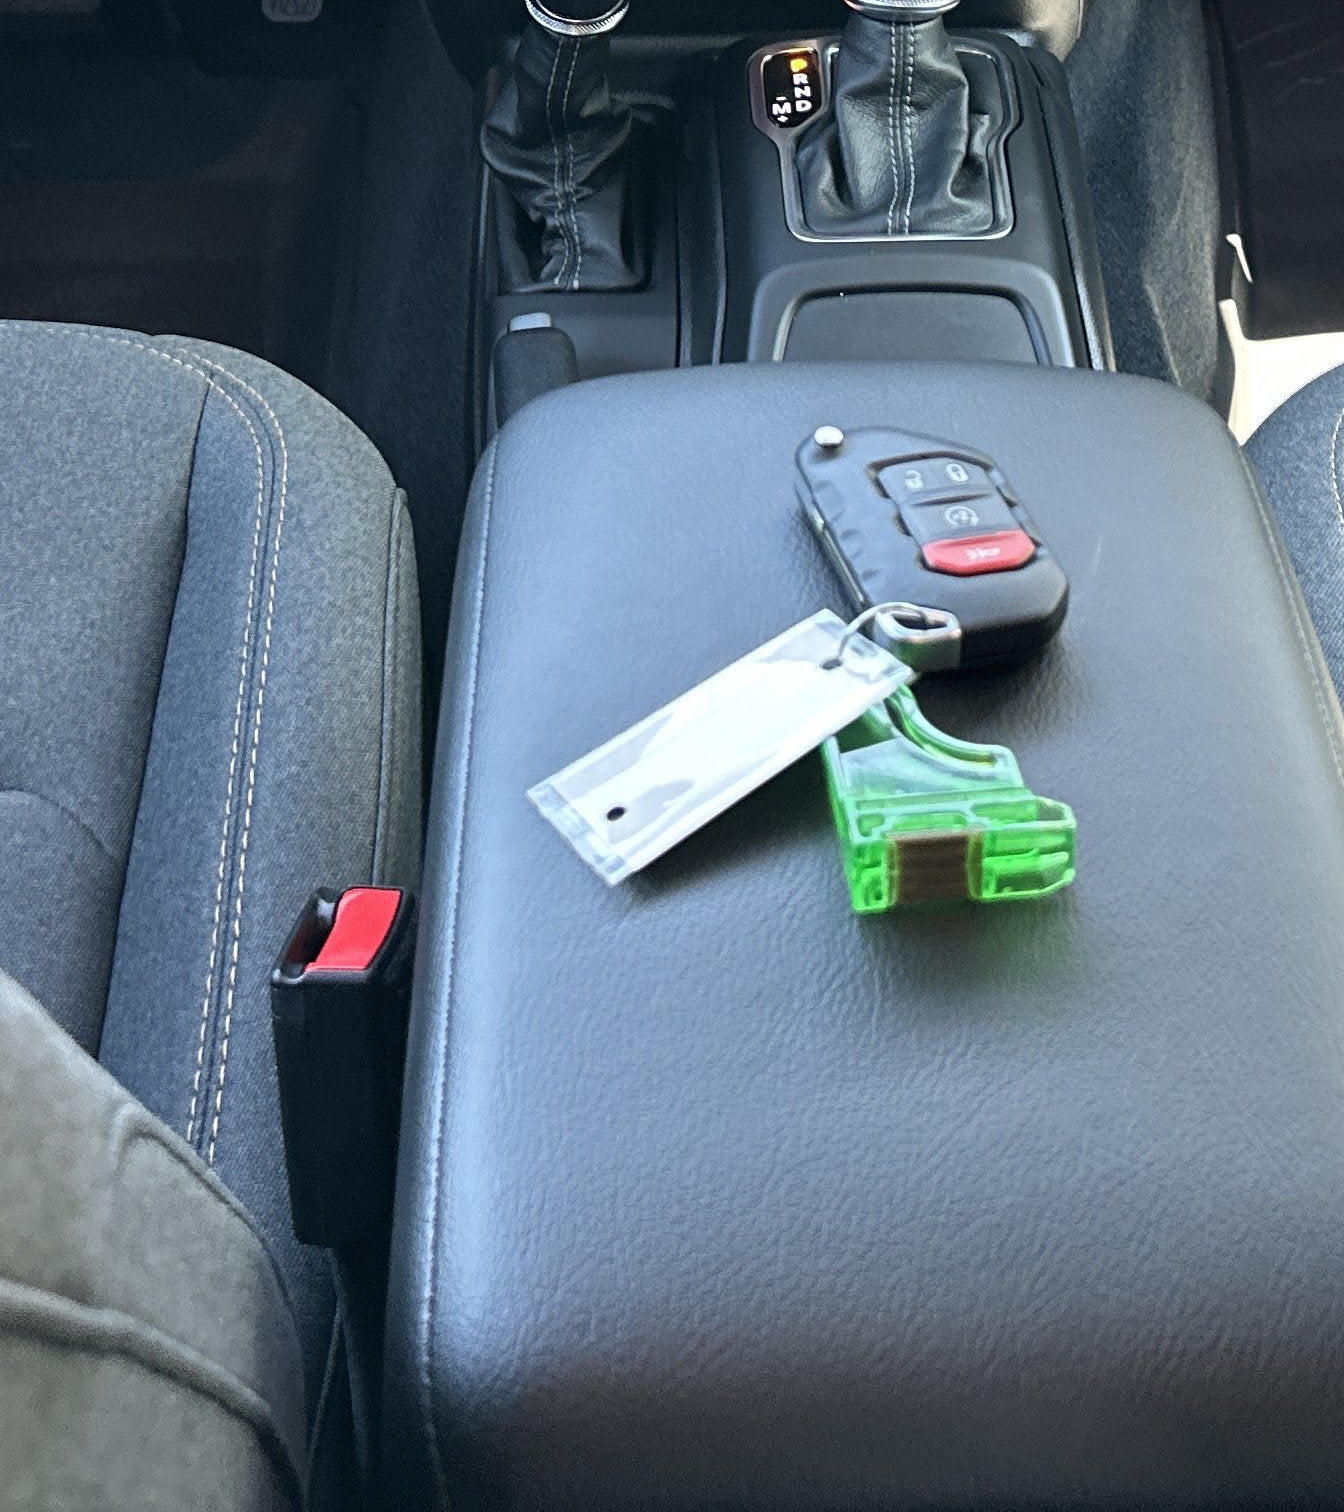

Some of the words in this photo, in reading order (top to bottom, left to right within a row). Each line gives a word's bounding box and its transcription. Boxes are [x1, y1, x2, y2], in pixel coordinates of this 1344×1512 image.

[793, 73, 809, 85] R
[794, 86, 811, 98] N
[772, 102, 792, 115] M
[796, 100, 812, 112] D
